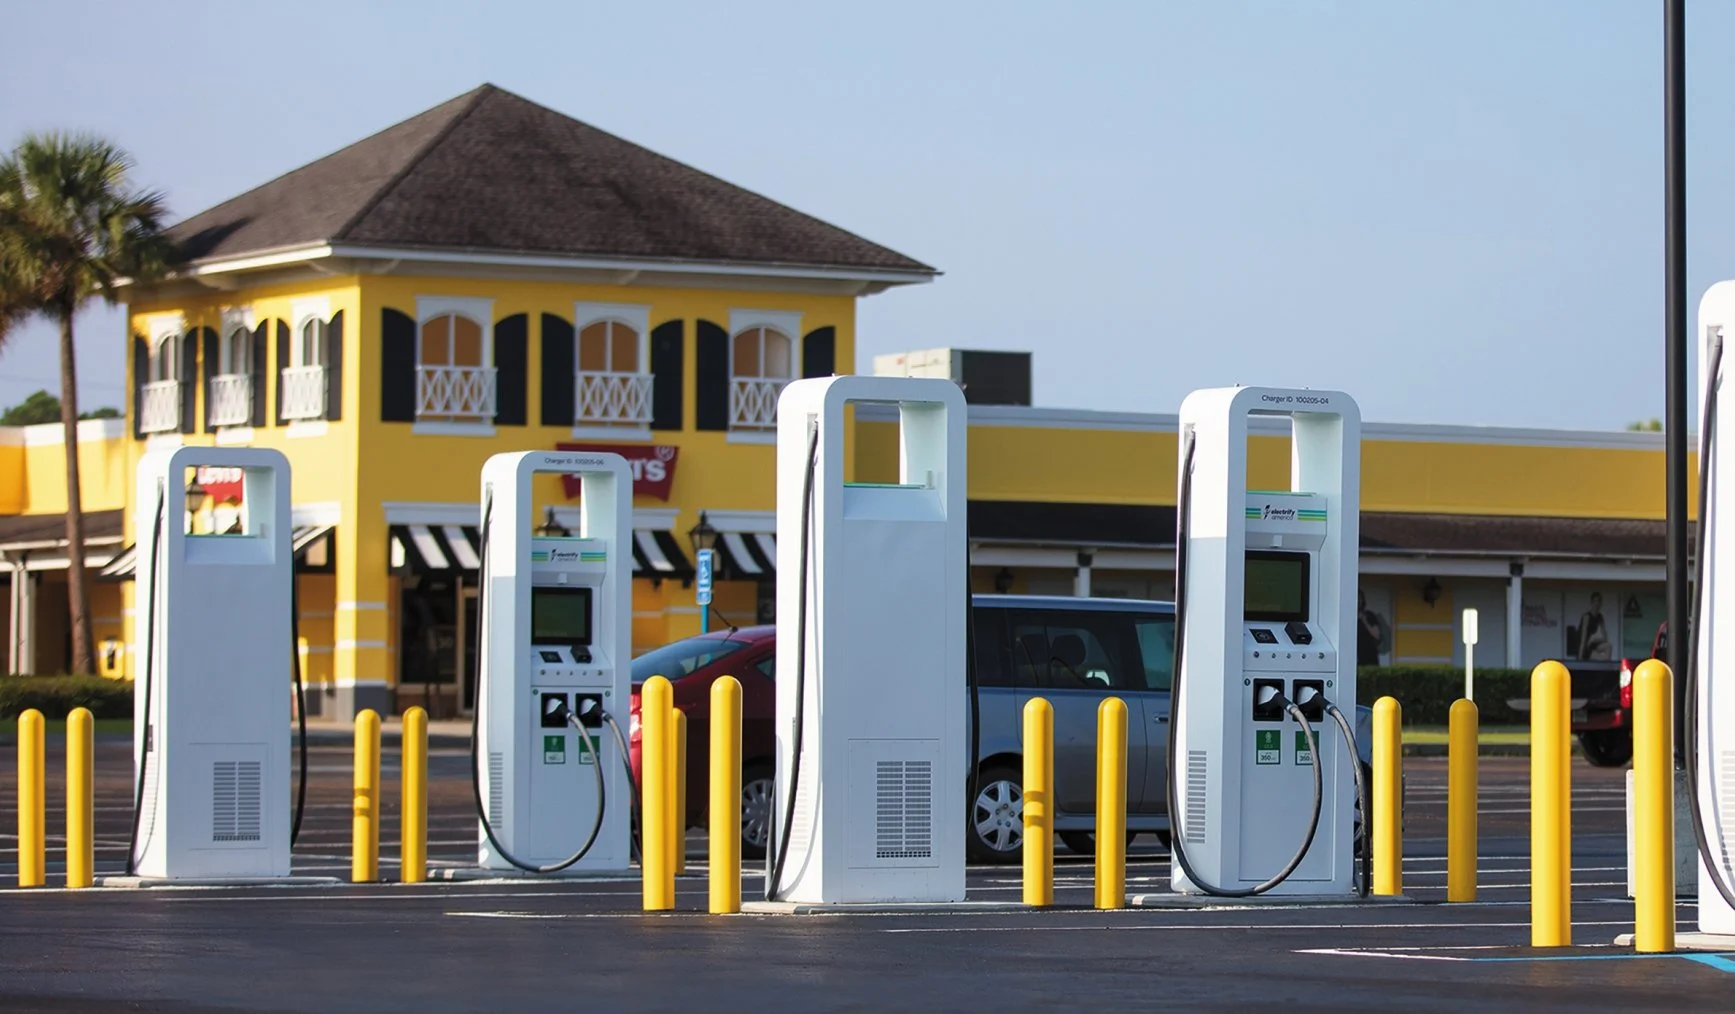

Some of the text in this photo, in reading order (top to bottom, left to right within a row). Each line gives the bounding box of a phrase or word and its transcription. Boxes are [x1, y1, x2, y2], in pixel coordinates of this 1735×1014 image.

[1261, 394, 1285, 404] Charger
[1286, 395, 1294, 403] ID
[1271, 508, 1295, 517] electrify
